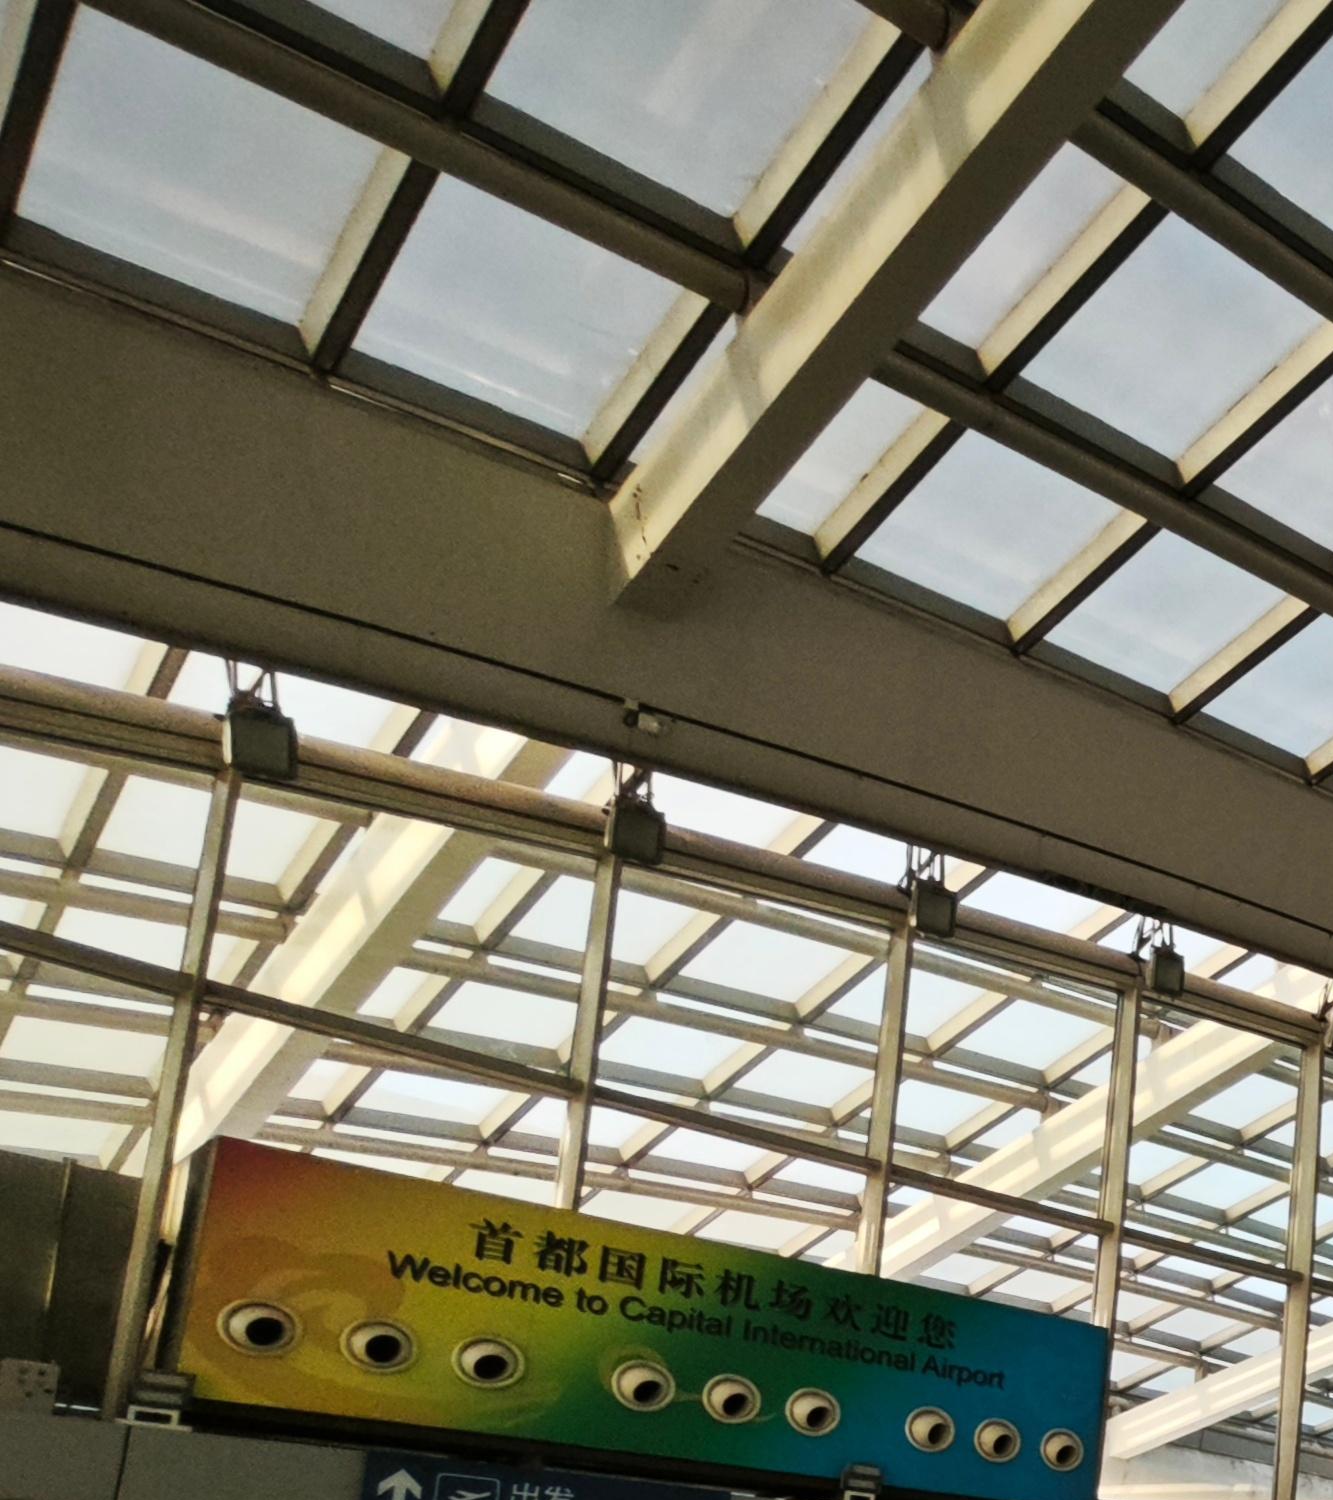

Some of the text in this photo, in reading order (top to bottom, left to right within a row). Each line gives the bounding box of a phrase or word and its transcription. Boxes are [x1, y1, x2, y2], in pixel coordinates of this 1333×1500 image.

[387, 1250, 1006, 1391] Welcome to Capital International Airport
[469, 1218, 956, 1349] 首都国际机场欢迎您
